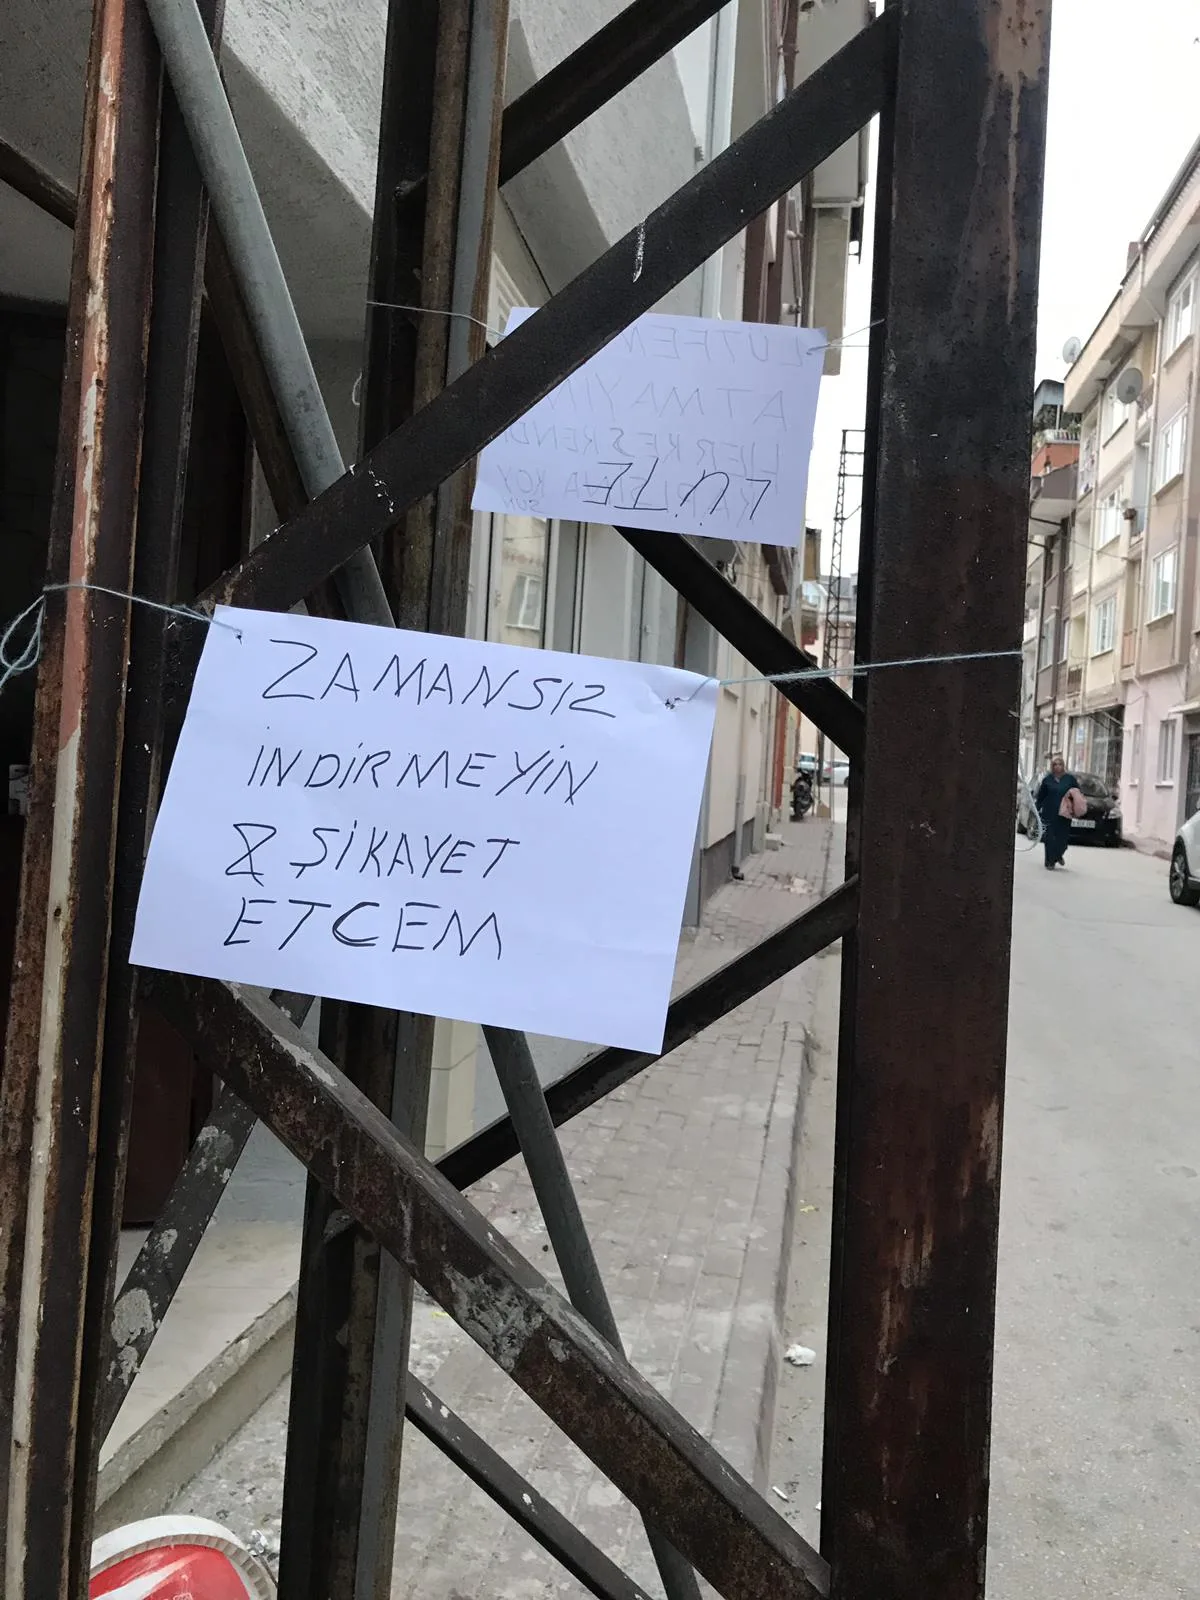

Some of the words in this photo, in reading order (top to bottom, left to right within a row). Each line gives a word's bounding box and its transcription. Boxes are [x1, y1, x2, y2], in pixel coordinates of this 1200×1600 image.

[261, 638, 616, 719] ZAMANSIZ
[246, 725, 599, 806] İNDİRMEYİN
[288, 819, 521, 879] ŞİKAYET
[223, 896, 503, 960] ETCEM
